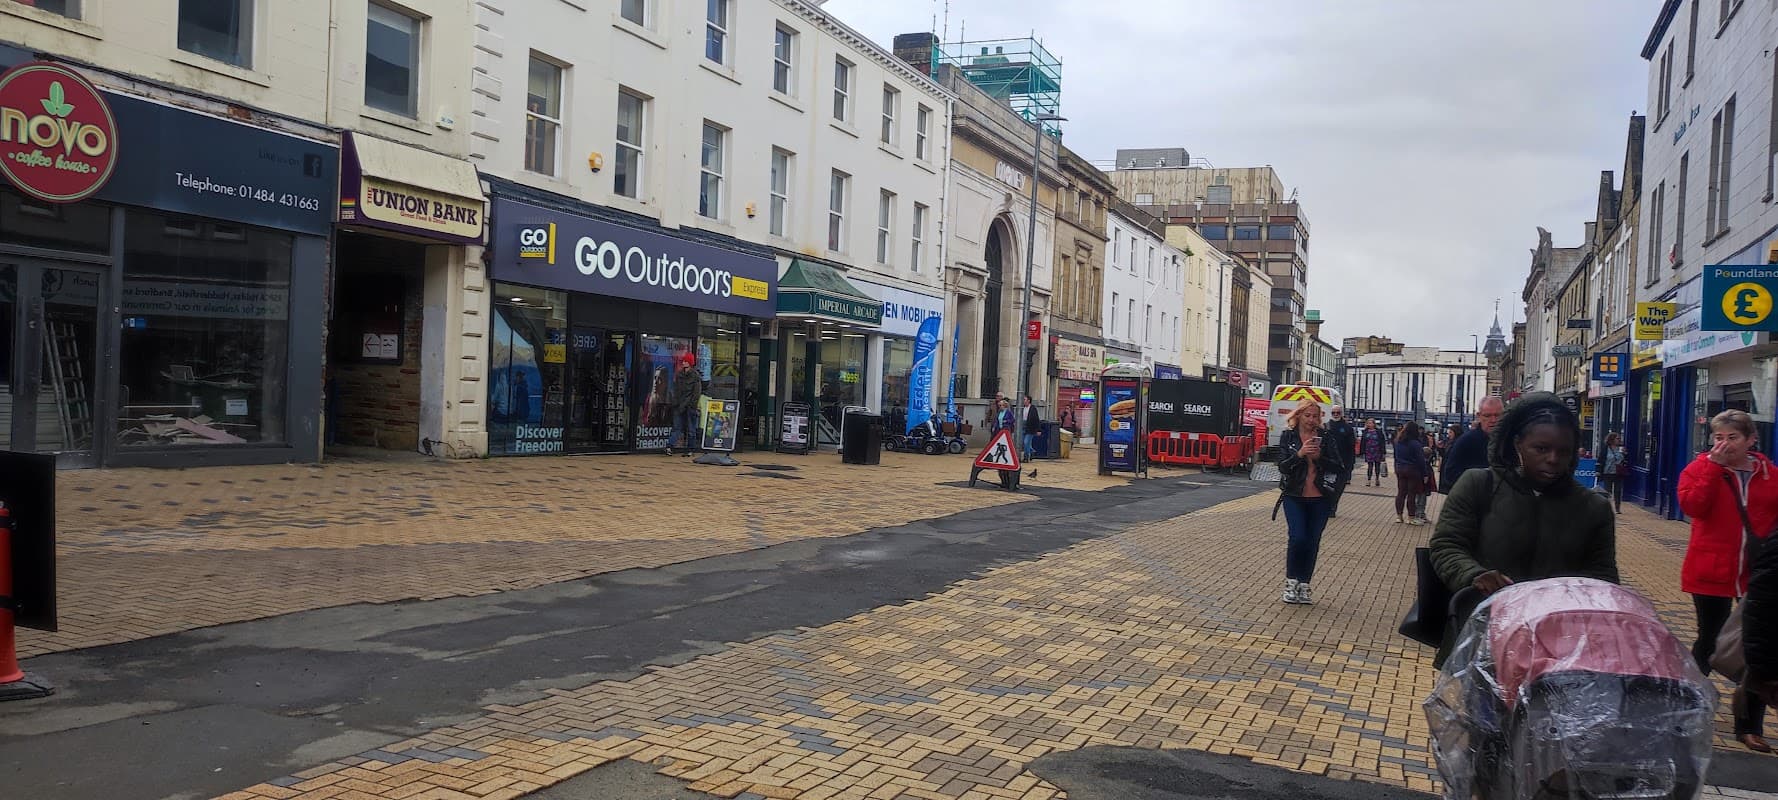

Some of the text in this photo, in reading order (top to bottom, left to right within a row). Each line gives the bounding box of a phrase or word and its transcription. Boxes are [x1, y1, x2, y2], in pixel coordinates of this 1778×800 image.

[1, 106, 107, 157] novo
[16, 149, 90, 173] coffee house
[176, 172, 319, 211] Telephone: 01484 431663
[372, 188, 478, 225] UNION BANK
[520, 228, 548, 246] GO
[574, 236, 767, 298] GO Outdoors Express
[818, 298, 878, 320] IMPERIAL ARCADE
[1648, 307, 1669, 316] The
[912, 365, 928, 410] Eden
[923, 367, 932, 411] MOBILITY
[1184, 404, 1211, 413] SEARCH
[515, 424, 564, 440] Discover
[636, 424, 672, 437] Discover
[515, 439, 563, 452] Freedom
